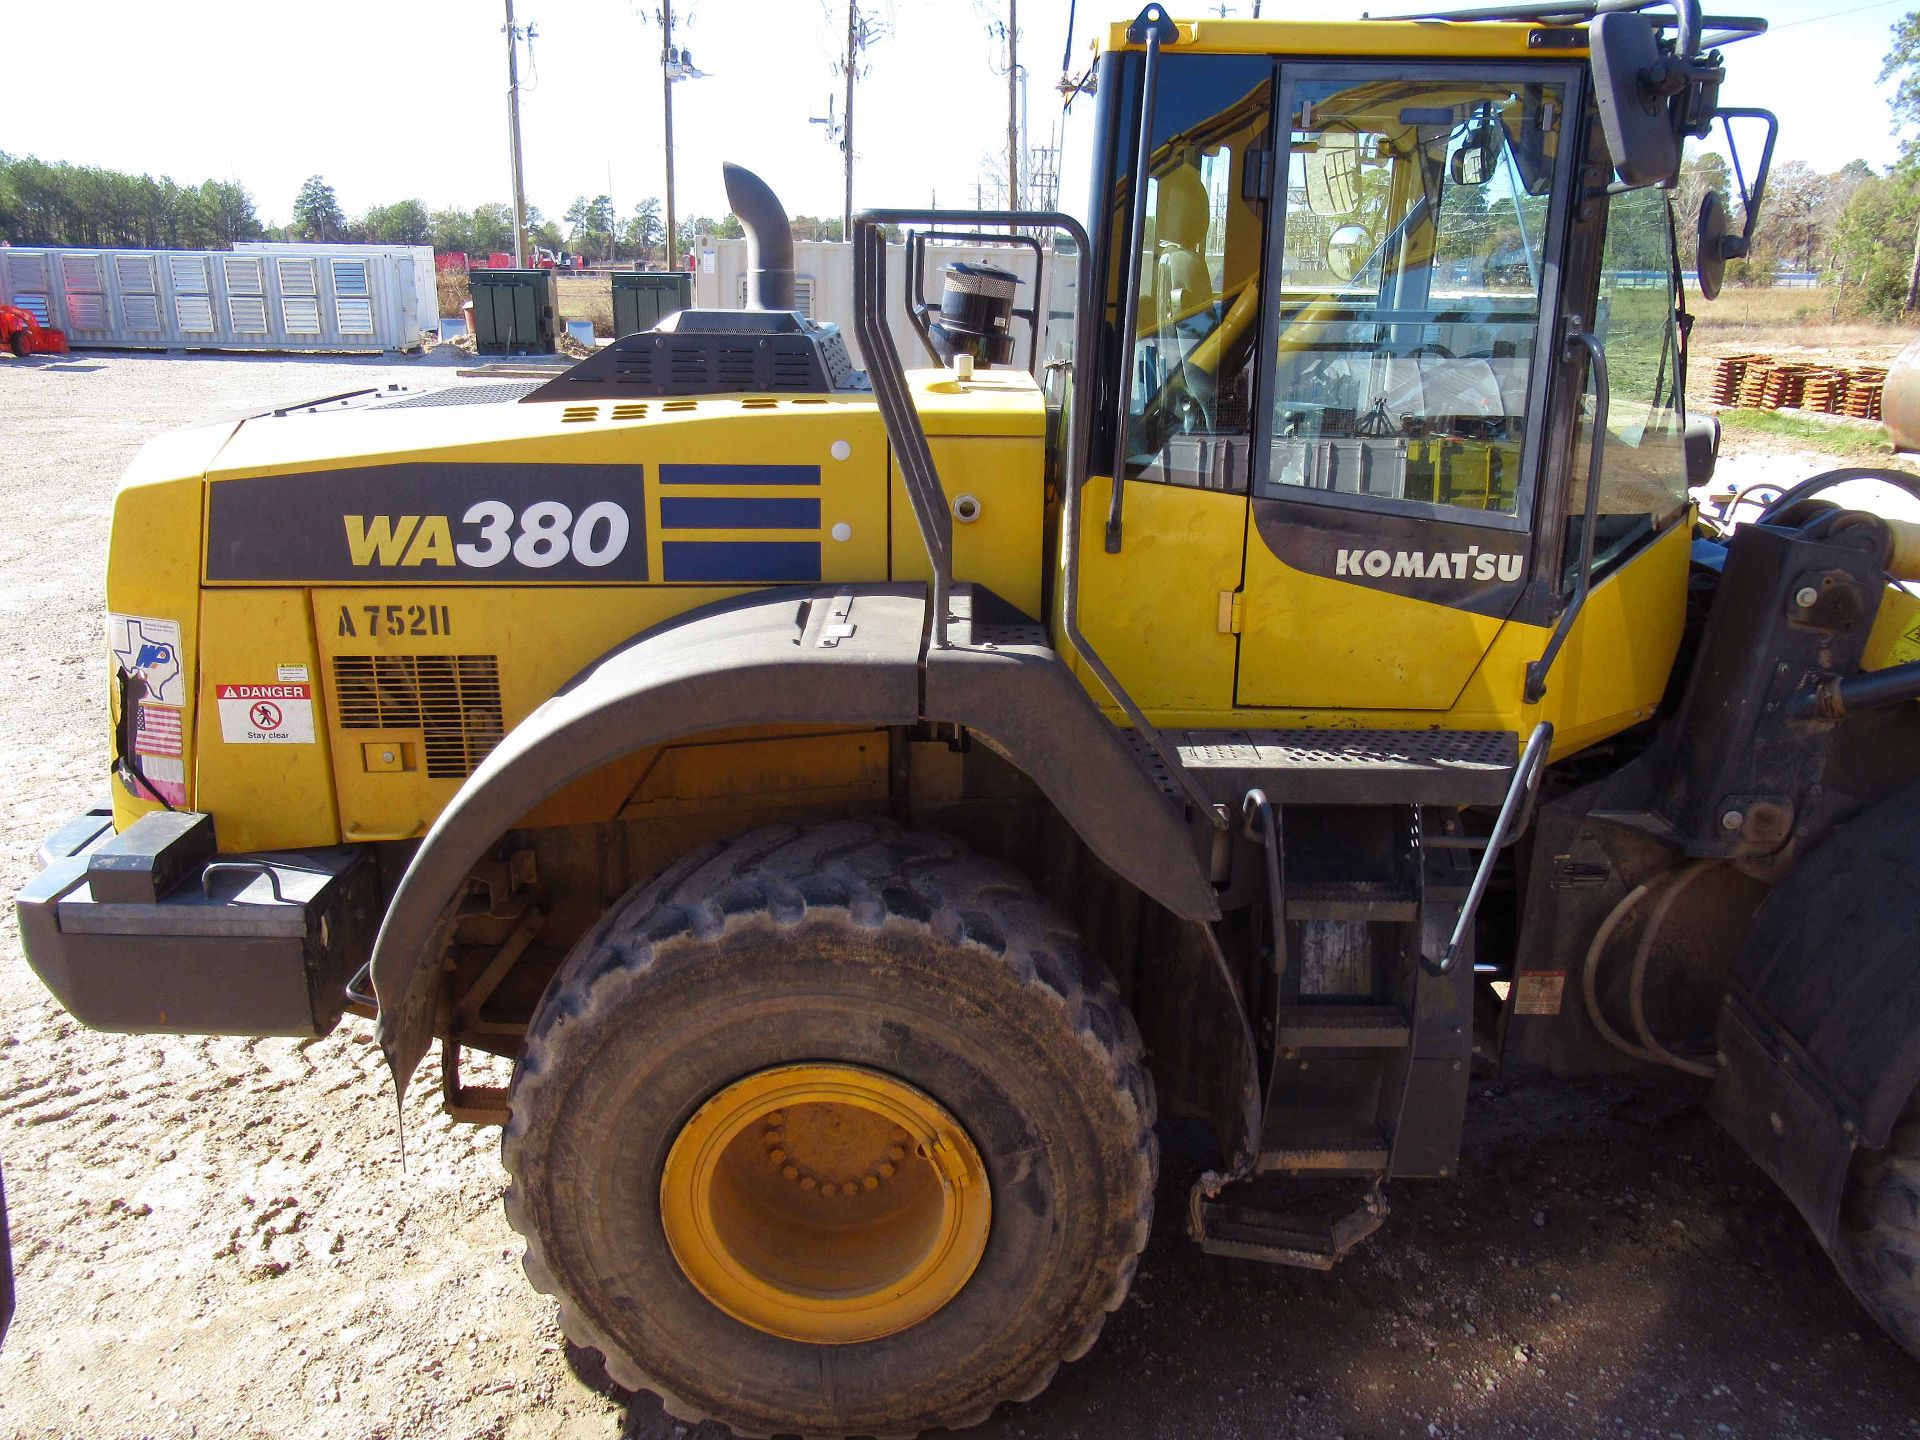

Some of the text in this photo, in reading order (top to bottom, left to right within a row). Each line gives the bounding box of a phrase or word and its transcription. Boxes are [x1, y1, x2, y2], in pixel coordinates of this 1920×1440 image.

[344, 500, 630, 568] WA380
[1335, 545, 1524, 582] KOMATSU
[240, 686, 304, 698] DANGER
[247, 731, 290, 740] Stay clear
